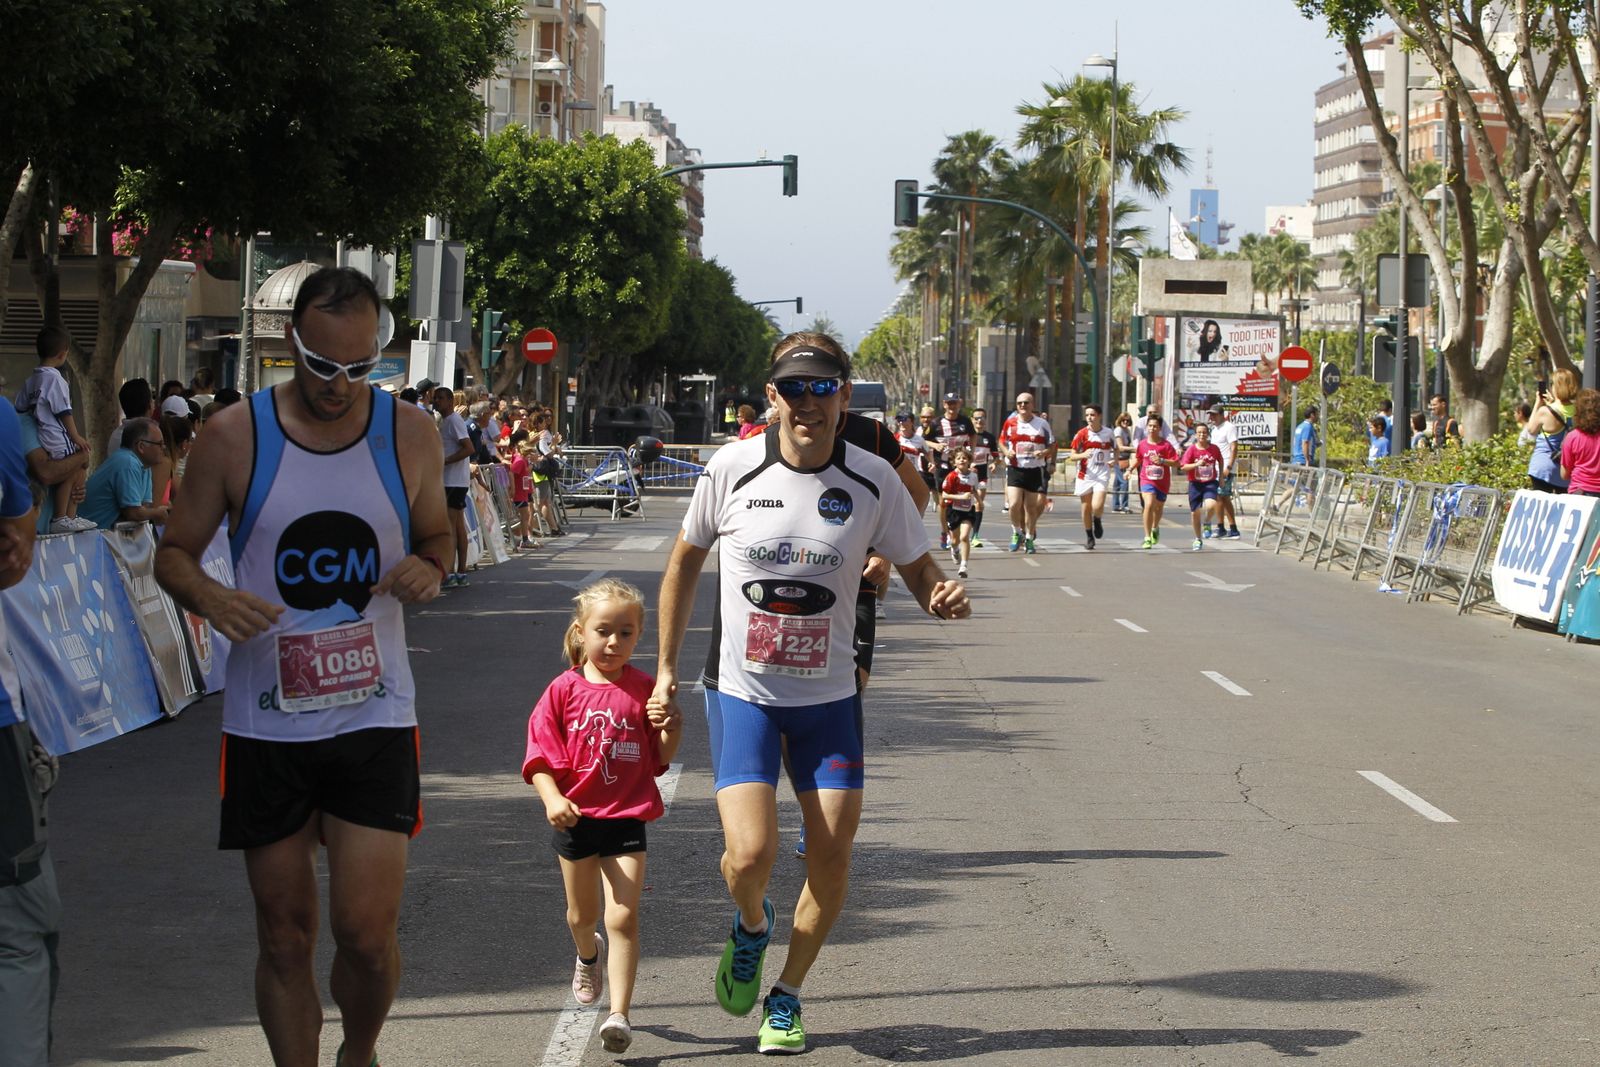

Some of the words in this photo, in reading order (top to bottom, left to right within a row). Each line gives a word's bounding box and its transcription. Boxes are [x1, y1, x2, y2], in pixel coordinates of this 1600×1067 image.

[1229, 331, 1251, 343] TODO
[1253, 328, 1277, 340] TIENE
[1236, 424, 1271, 436] TENCIA
[746, 499, 784, 510] joma
[819, 498, 851, 513] CGM
[277, 548, 377, 586] CGM
[772, 633, 826, 653] 1224
[310, 645, 377, 677] 1086
[319, 677, 338, 687] PACO
